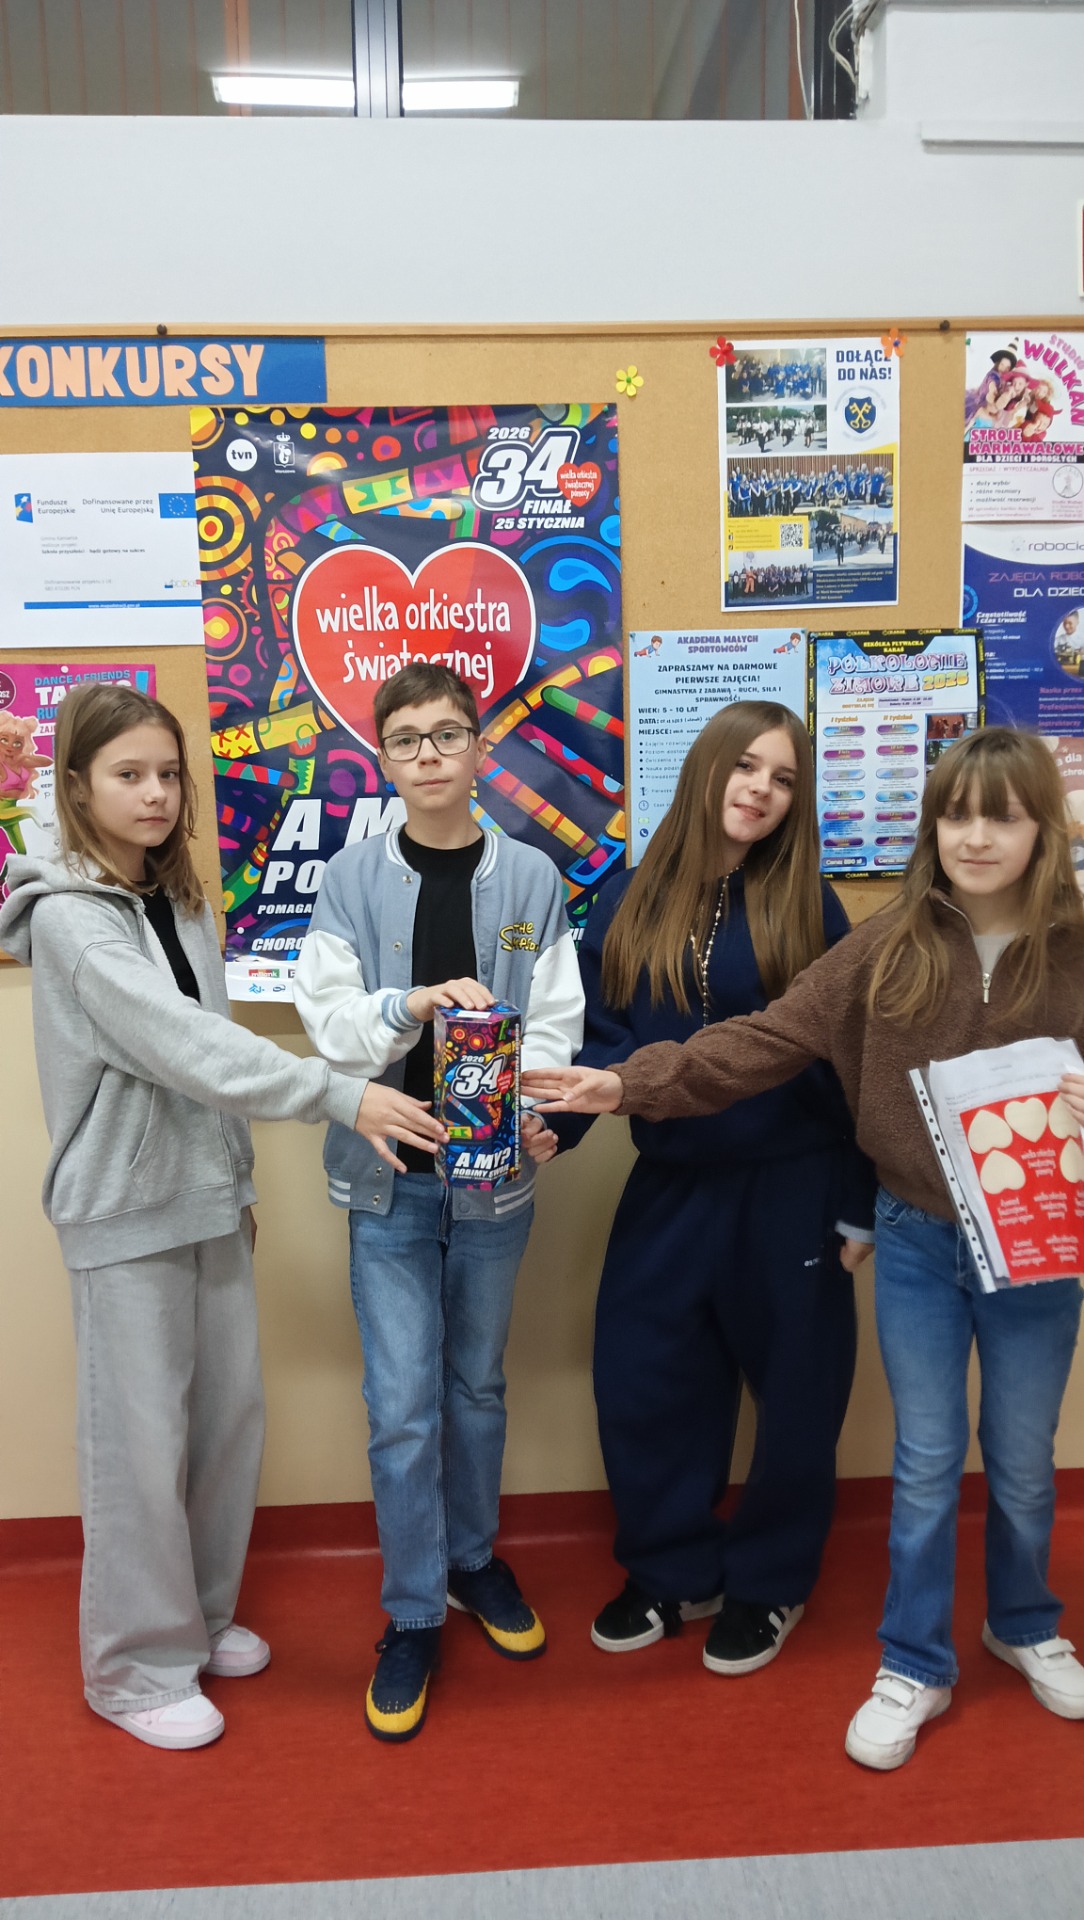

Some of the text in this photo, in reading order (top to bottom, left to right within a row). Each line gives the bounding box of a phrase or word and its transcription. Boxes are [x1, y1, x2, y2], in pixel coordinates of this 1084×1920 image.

[838, 368, 891, 380] DO NAS!
[1024, 339, 1084, 426] WULKAN
[488, 427, 531, 440] 2026
[970, 429, 1022, 441] STROJE
[969, 442, 1084, 455] KARNAWAŁOWE
[231, 450, 252, 460] tvn
[476, 431, 577, 507] 34
[522, 500, 572, 514] FINAŁ
[495, 517, 585, 529] 25 STYCZNIA
[989, 572, 1045, 583] ZAJĘCIA
[1014, 588, 1043, 598] DLA
[316, 586, 511, 633] wielka orkiestra
[677, 635, 758, 644] AKADEMIA MAŁYCH
[688, 643, 748, 653] SPORTOWCÓW
[828, 652, 968, 675] PÓŁKOLONIE
[35, 676, 72, 686] DANCE
[83, 670, 130, 680] FRIENDS
[722, 675, 760, 684] ZAJĘCIA!
[830, 671, 969, 694] ZIMOWE 2026
[37, 708, 59, 720] RU
[1065, 753, 1082, 764] dla
[272, 798, 322, 851] A
[461, 1055, 484, 1063] 2026
[453, 1056, 505, 1097] 34
[455, 1147, 511, 1169] A MY?
[453, 1168, 488, 1178] ROBIMY
